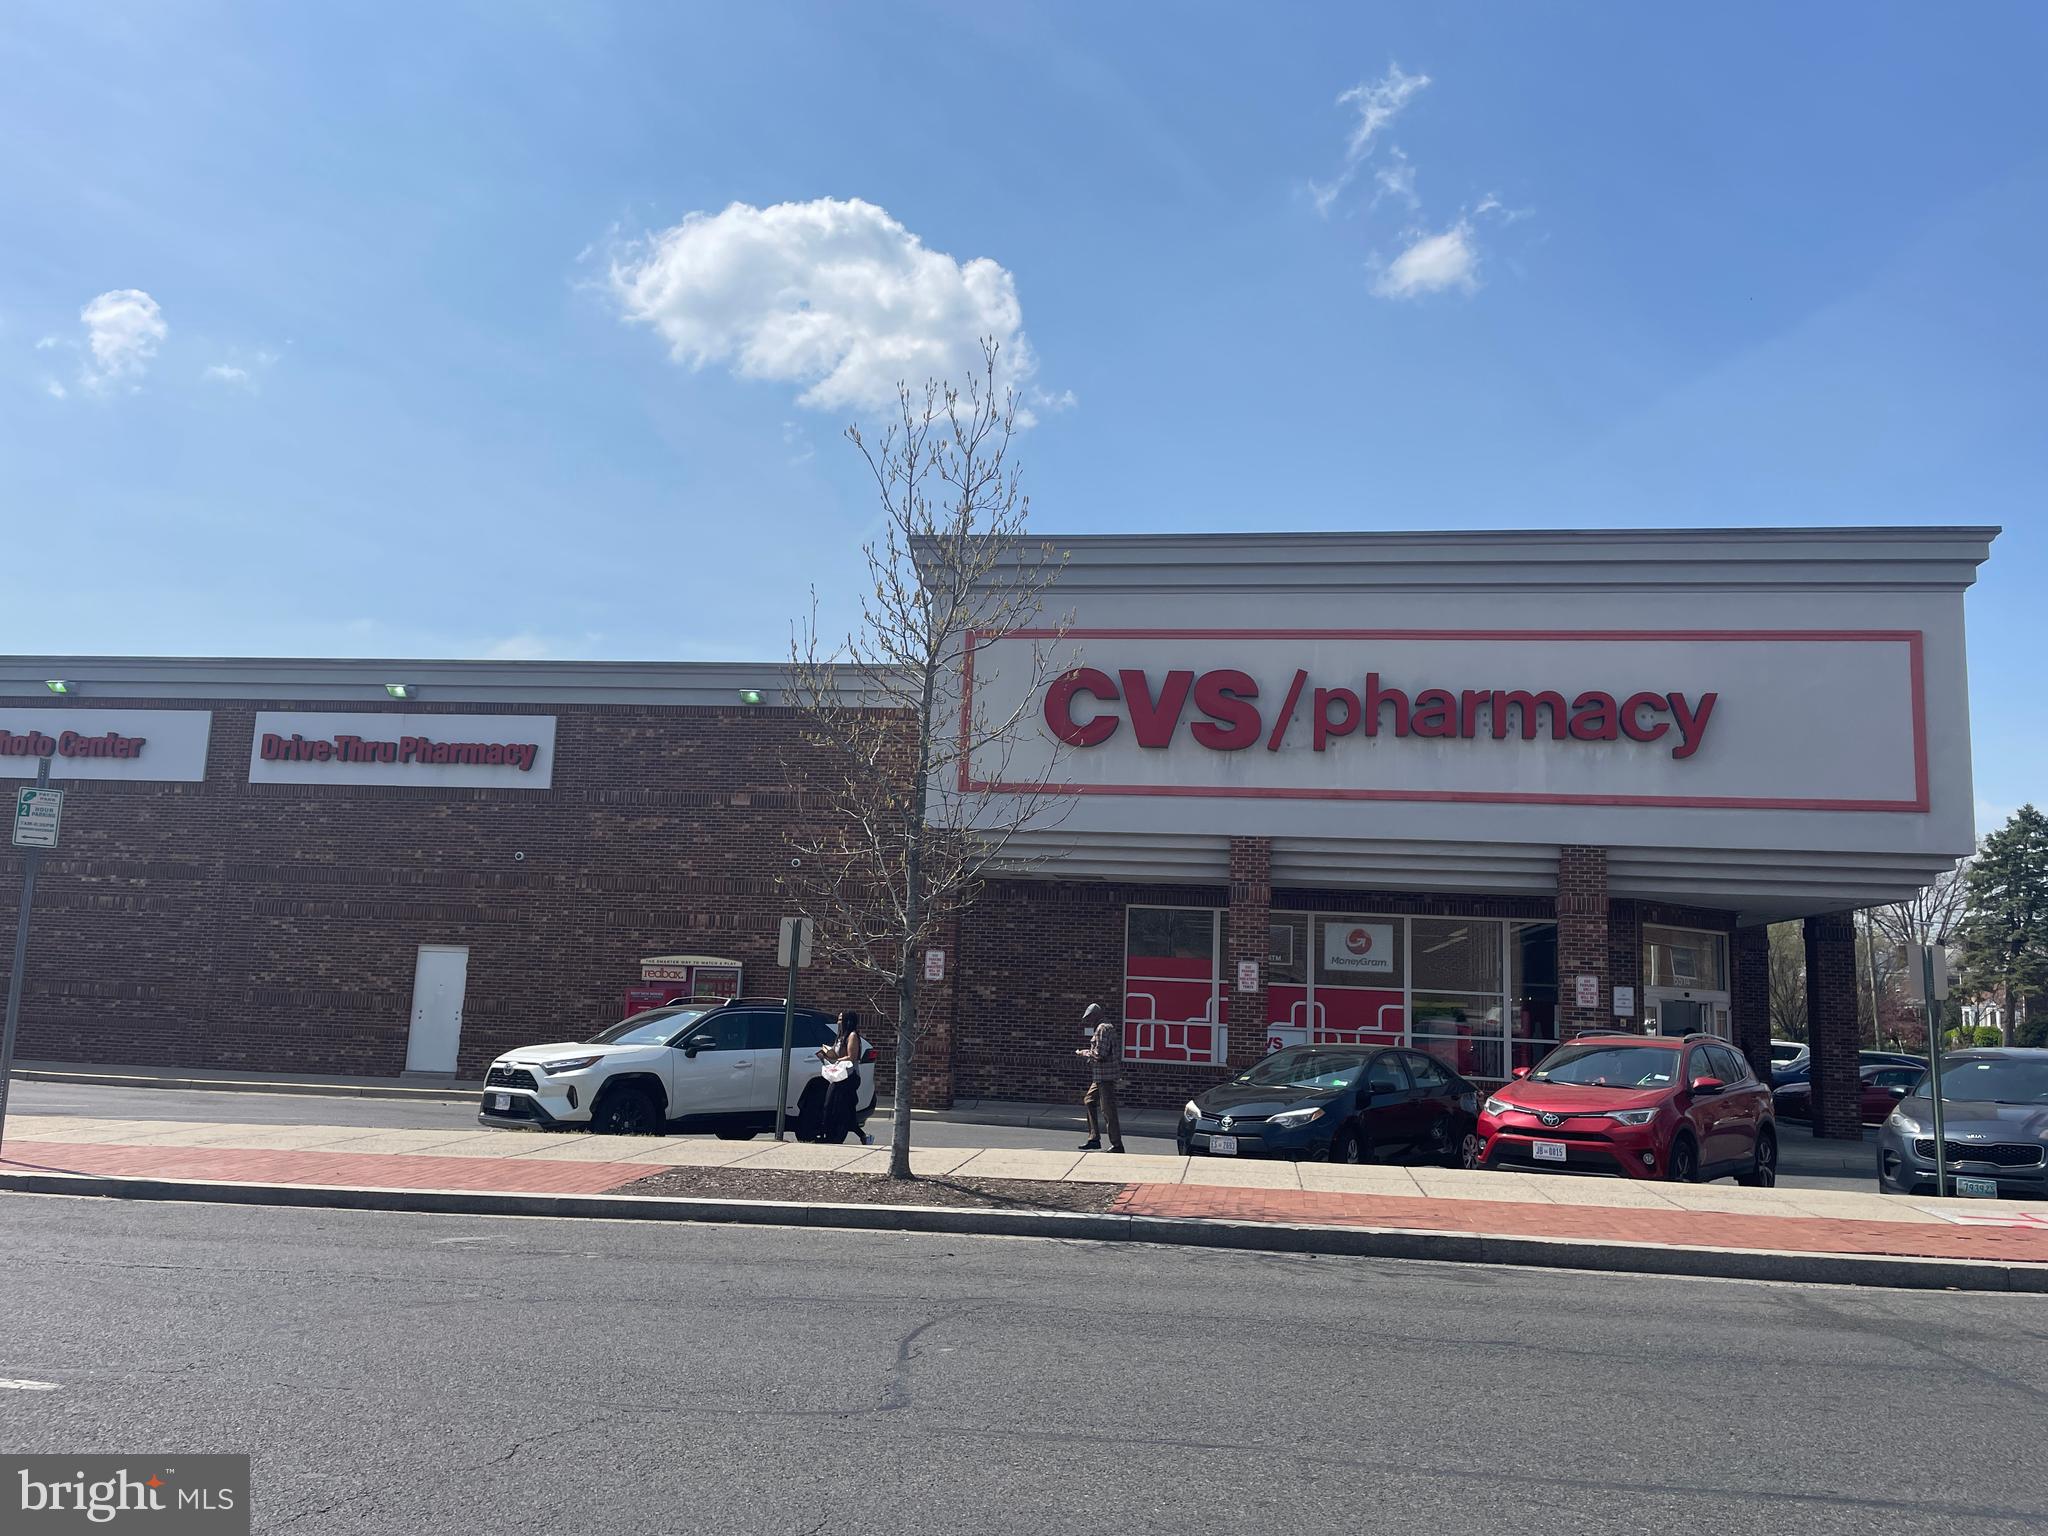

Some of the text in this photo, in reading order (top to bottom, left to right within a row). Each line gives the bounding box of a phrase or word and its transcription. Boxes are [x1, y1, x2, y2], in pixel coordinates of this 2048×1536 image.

[1044, 667, 1718, 760] CVS/pharmacy
[58, 730, 147, 758] Center
[260, 733, 538, 771] Drive-Thru Pharmacy
[21, 804, 28, 815] 2
[1331, 956, 1387, 967] MoneyGram
